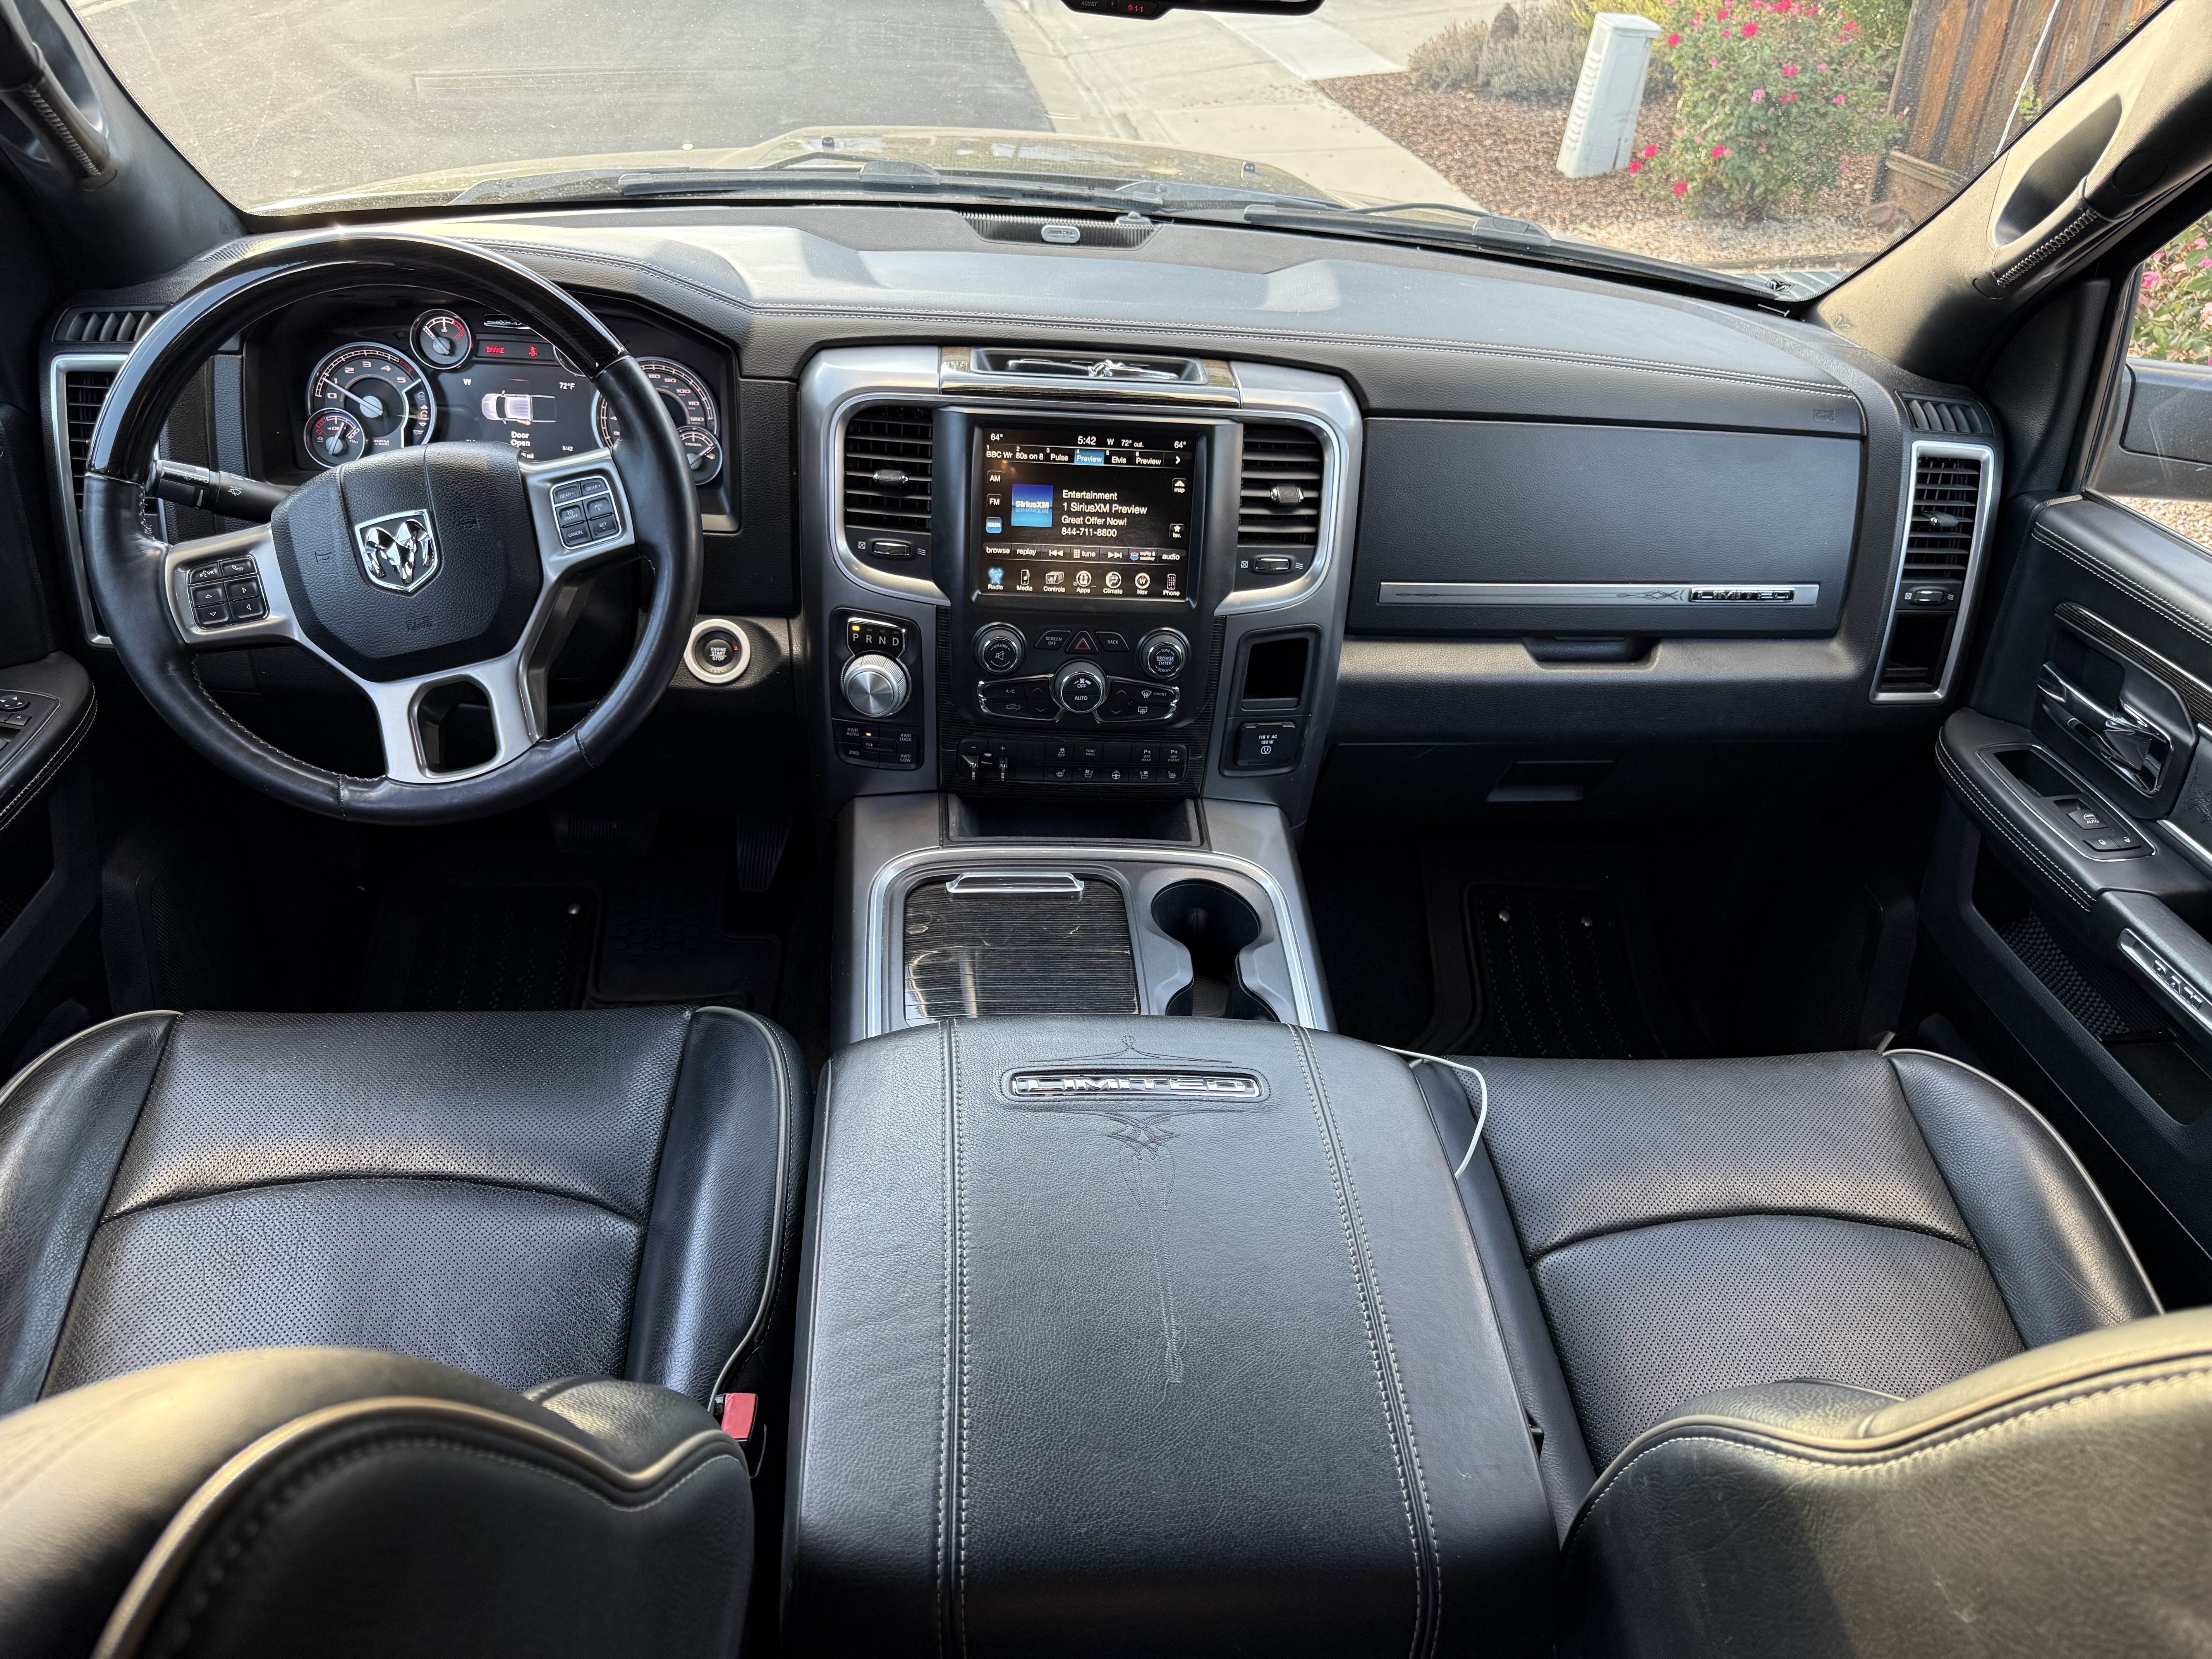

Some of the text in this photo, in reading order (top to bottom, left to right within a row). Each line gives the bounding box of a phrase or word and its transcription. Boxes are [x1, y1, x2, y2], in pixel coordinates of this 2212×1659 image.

[559, 382, 575, 390] 72°F
[511, 439, 530, 447] Open
[1077, 436, 1096, 445] 5:42
[1062, 489, 1118, 500] Entertainment
[1063, 502, 1147, 514] 1 SiriusXM Preview
[1061, 515, 1127, 526] Great Offer Now!
[1061, 527, 1117, 537] 844-711-8800
[866, 635, 872, 643] R
[879, 637, 886, 645] N
[892, 638, 899, 646] D
[1026, 1078, 1246, 1093] LIMITED
